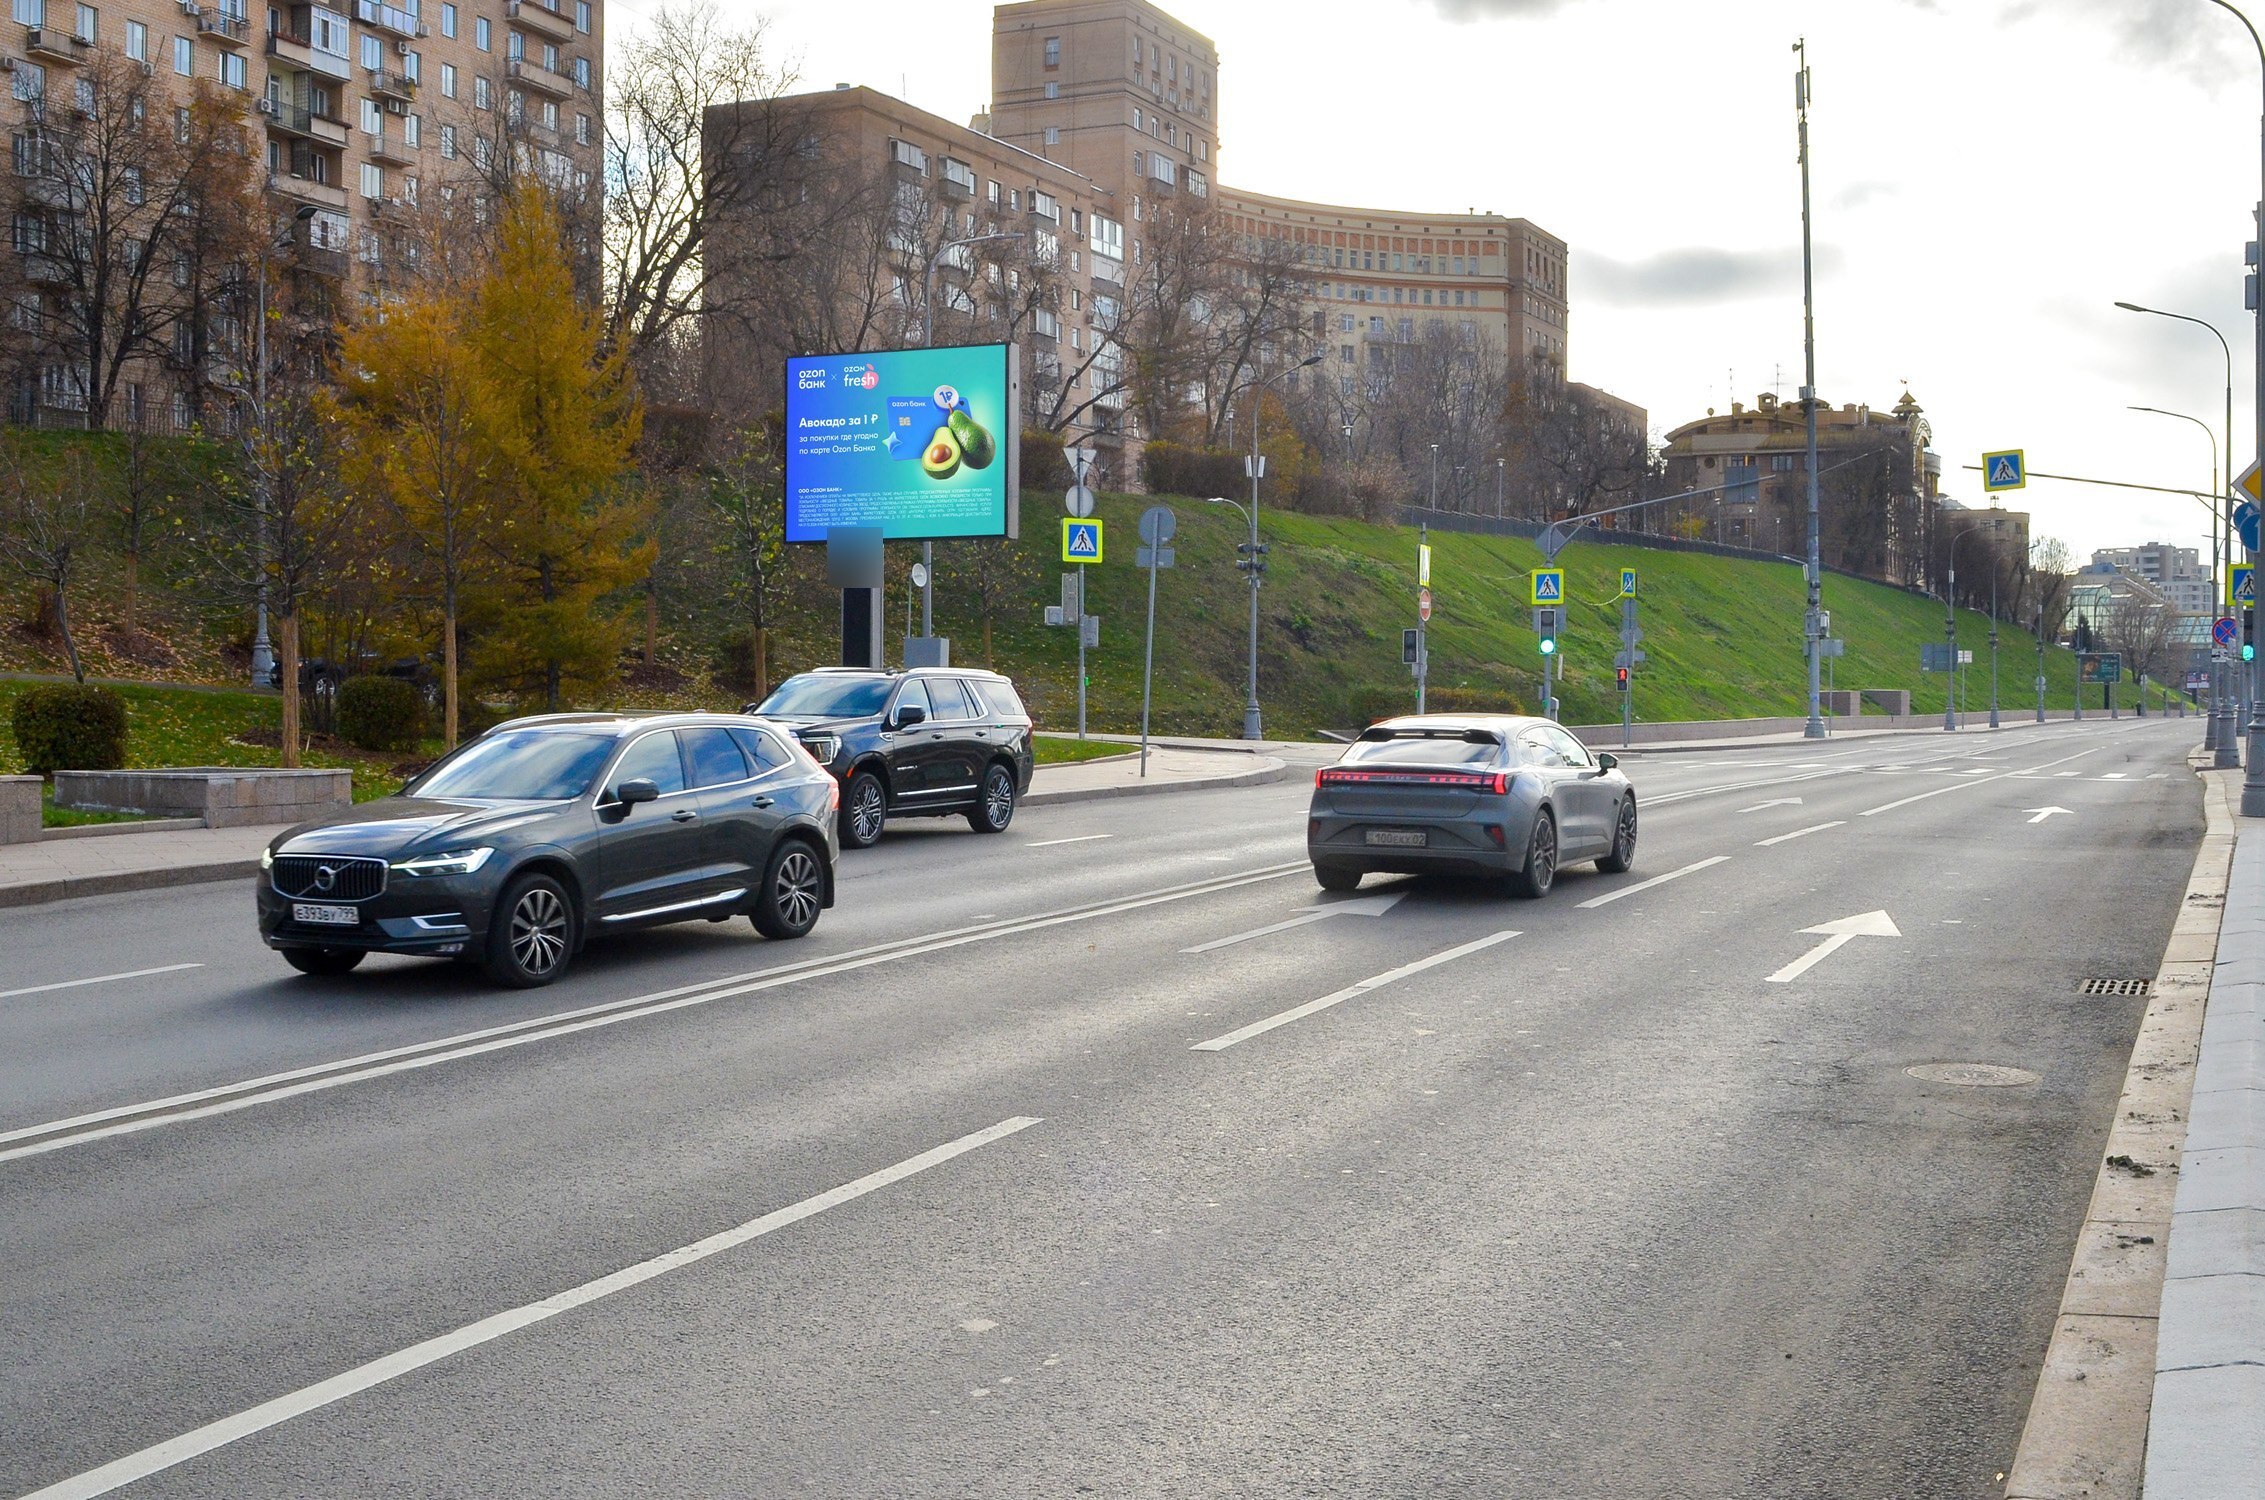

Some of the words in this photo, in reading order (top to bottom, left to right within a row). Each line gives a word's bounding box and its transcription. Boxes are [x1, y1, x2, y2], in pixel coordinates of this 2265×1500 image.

[799, 369, 826, 378] ozon
[798, 379, 826, 389] банк
[844, 373, 875, 387] fresh
[799, 418, 845, 428] Авокадо
[810, 434, 839, 442] покупки
[854, 433, 878, 442] угодно
